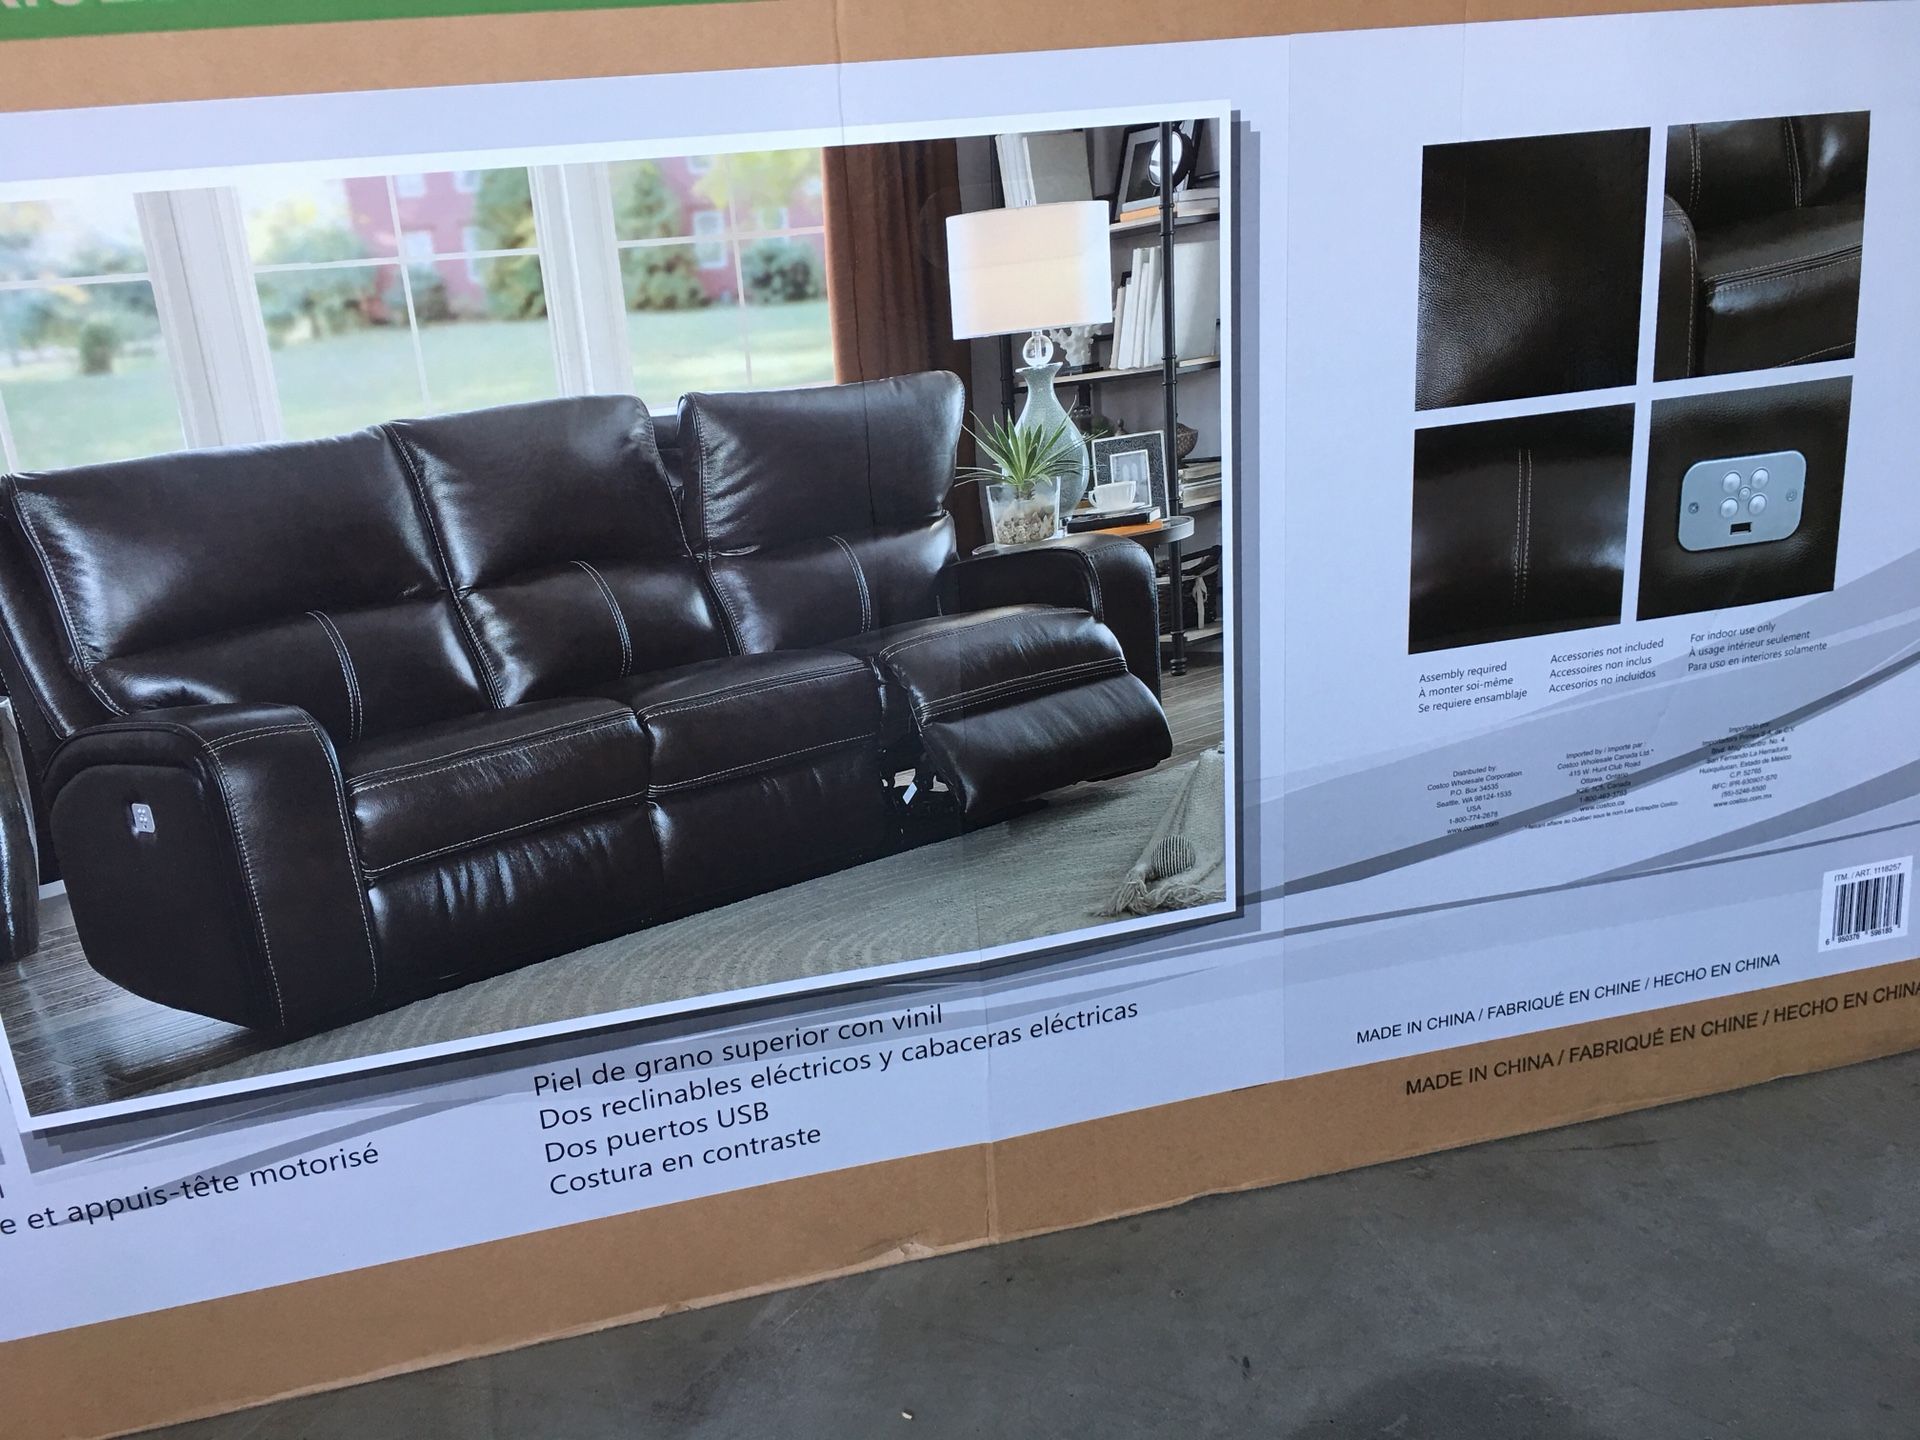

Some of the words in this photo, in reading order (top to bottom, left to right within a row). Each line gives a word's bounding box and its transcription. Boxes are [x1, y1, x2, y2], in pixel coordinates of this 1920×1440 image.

[1690, 632, 1704, 642] For
[1707, 628, 1737, 640] indoor
[1740, 626, 1755, 636] use
[1757, 622, 1776, 634] only
[1550, 648, 1604, 664] Accessories
[1606, 645, 1622, 656] not
[1624, 638, 1664, 653] included
[1688, 647, 1696, 658] À
[1698, 645, 1725, 657] usage
[1728, 638, 1764, 652] intérieur
[1766, 630, 1810, 646] seulement
[1550, 664, 1603, 679] Accessoires
[1606, 660, 1624, 670] non
[1626, 656, 1652, 668] inclus
[1688, 661, 1707, 672] Para
[1710, 659, 1726, 668] uso
[1728, 657, 1740, 666] en
[1742, 650, 1782, 664] interiores
[1784, 642, 1828, 657] solamente
[1419, 668, 1464, 684] Assembly
[1467, 662, 1508, 677] required
[1549, 678, 1598, 694] Accesorios
[1600, 676, 1613, 686] no
[1615, 669, 1656, 684] incluidos
[1418, 686, 1426, 698] À
[1428, 686, 1464, 697] monter
[1466, 676, 1514, 692] soi-même
[1418, 702, 1430, 714] Se
[1432, 698, 1472, 712] requiere
[1474, 688, 1528, 705] ensamblaje
[1557, 762, 1579, 770] Costco
[1580, 756, 1612, 766] Wholesale
[1614, 752, 1638, 760] Canada
[1566, 750, 1594, 759] Imported
[1452, 767, 1487, 778] Distributed
[1488, 764, 1496, 772] by
[1592, 766, 1608, 774] Hunt
[1608, 763, 1622, 772] Club
[1624, 760, 1641, 768] Road
[1427, 782, 1450, 791] Costco
[1451, 777, 1484, 787] Wholesale
[1486, 770, 1522, 782] Corporation
[1479, 783, 1500, 792] 34535
[1466, 804, 1482, 812] USA
[1874, 862, 1902, 874] 1118257
[1825, 938, 1830, 946] 6
[1838, 932, 1860, 944] 950376
[1356, 1024, 1402, 1045] MADE
[1407, 1019, 1423, 1035] IN
[1426, 1010, 1476, 1030] CHINA
[1487, 991, 1565, 1020] FABRIQUÉ
[1569, 988, 1590, 1005] EN
[1594, 978, 1641, 1000] CHINE
[1654, 967, 1708, 989] HECHO
[1711, 962, 1732, 978] EN
[1735, 953, 1780, 973] CHINA
[533, 1067, 582, 1096] Piel
[592, 1062, 626, 1086] de
[636, 1049, 713, 1084] grano
[722, 1026, 830, 1062] superior
[838, 1018, 884, 1040] con
[892, 1003, 942, 1030] vinil
[1406, 1070, 1463, 1096] MADE
[1469, 1065, 1488, 1084] IN
[1494, 1053, 1554, 1078] CHINA
[1569, 1027, 1664, 1064] FABRIQUÉ
[1670, 1024, 1696, 1043] EN
[1701, 1012, 1758, 1036] CHINE
[1774, 996, 1839, 1024] HECHO
[1843, 990, 1868, 1010] EN
[540, 1106, 592, 1130] Dos
[602, 1077, 742, 1118] reclinables
[750, 1053, 871, 1089] eléctricos
[879, 1050, 893, 1072] y
[902, 1027, 1022, 1062] cabaceras
[1030, 1002, 1138, 1038] eléctricas
[545, 1139, 598, 1163] Dos
[607, 1116, 708, 1156] puertos
[717, 1102, 770, 1129] USB
[550, 1162, 653, 1195] Costura
[662, 1153, 694, 1172] en
[702, 1126, 822, 1164] contraste
[27, 1207, 58, 1230] et
[68, 1174, 240, 1225] appuis-tête
[250, 1142, 380, 1187] motorisé
